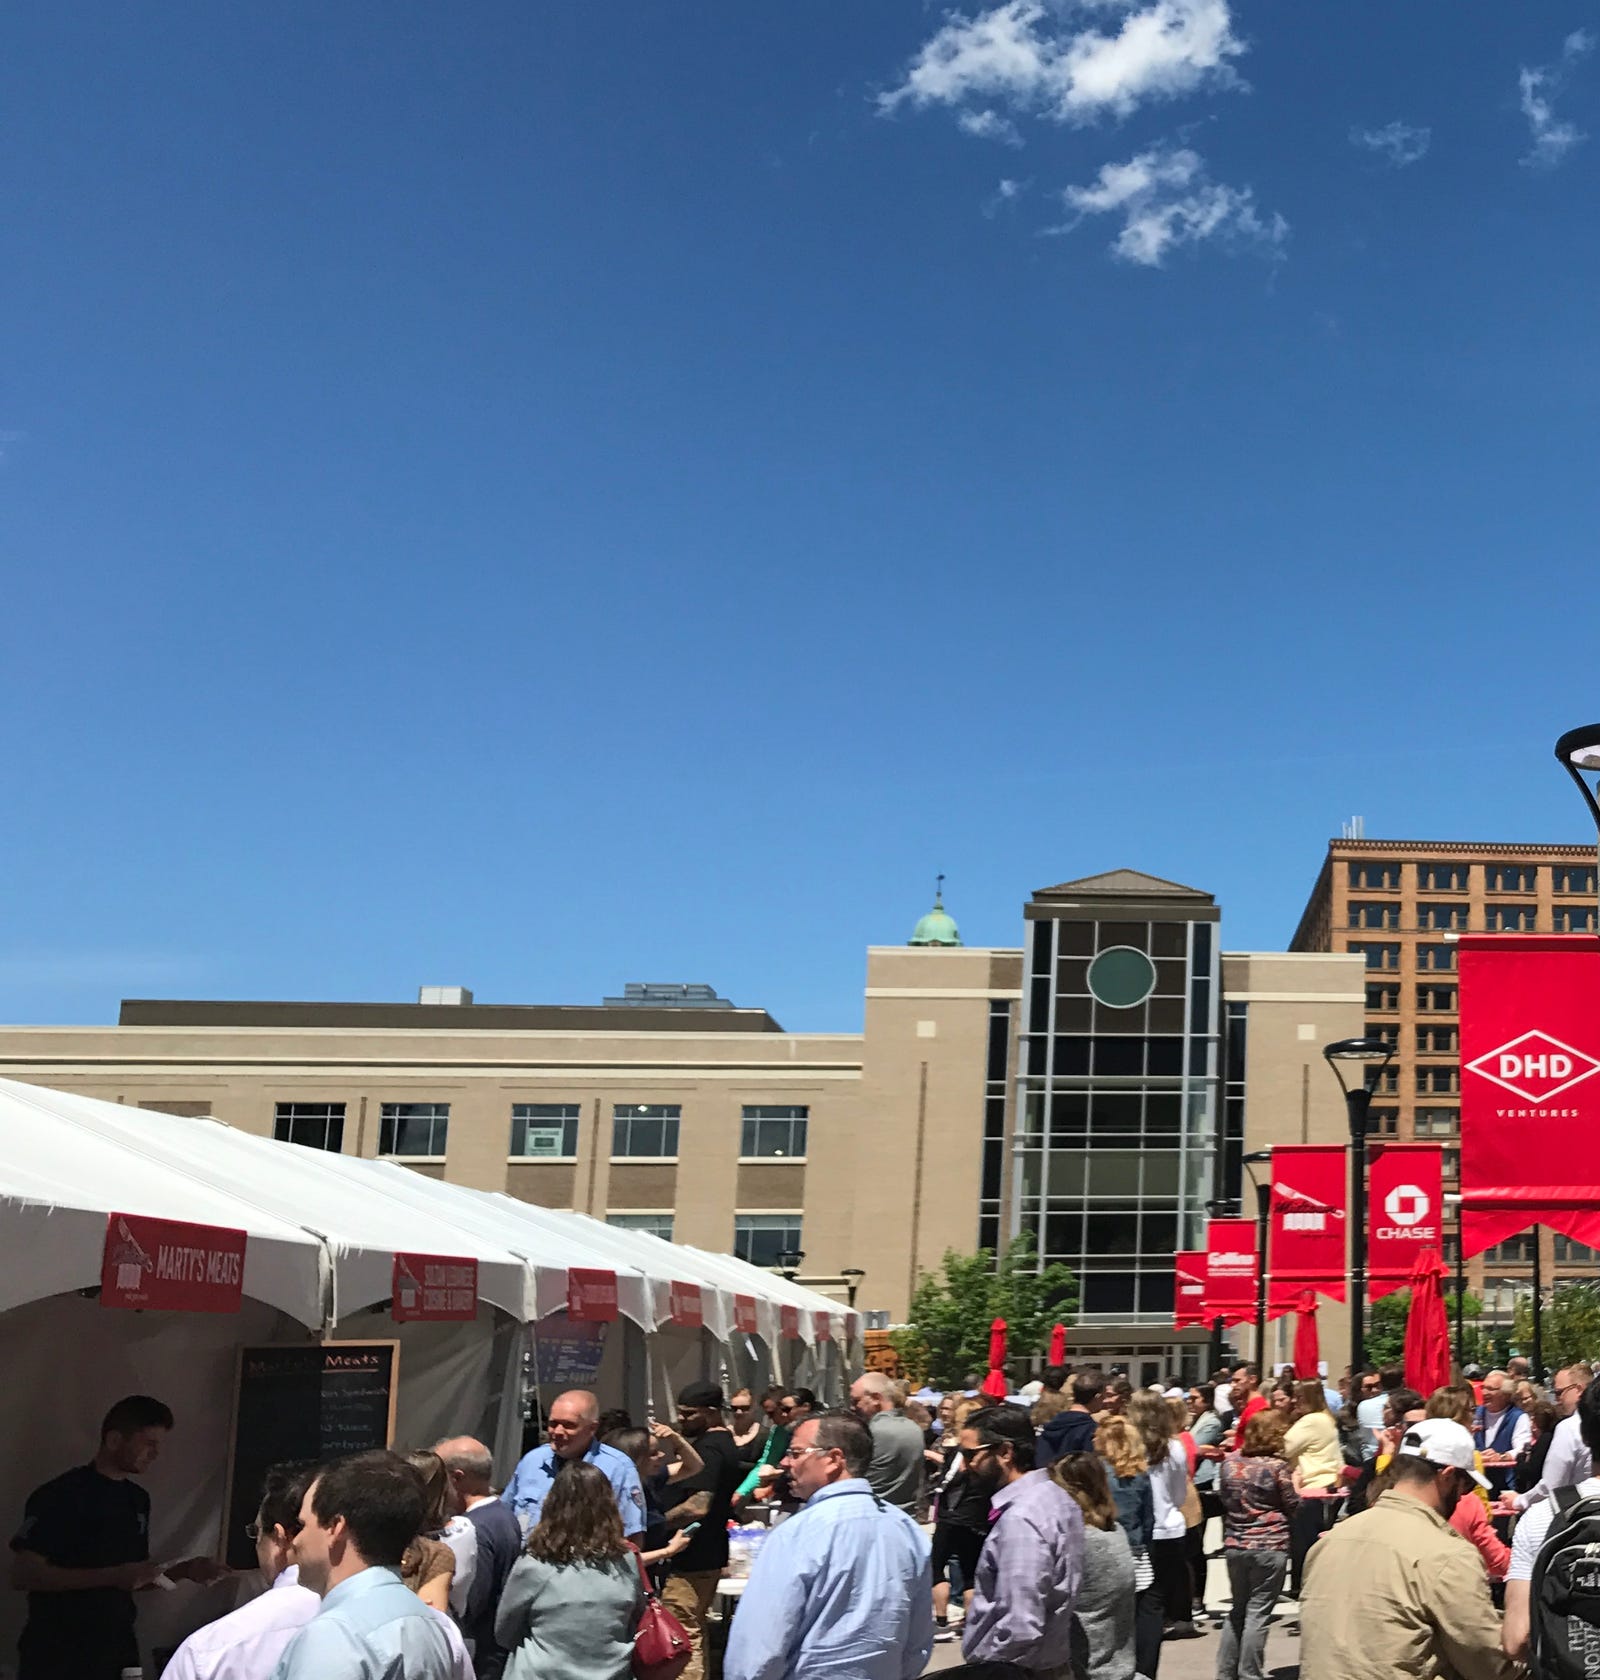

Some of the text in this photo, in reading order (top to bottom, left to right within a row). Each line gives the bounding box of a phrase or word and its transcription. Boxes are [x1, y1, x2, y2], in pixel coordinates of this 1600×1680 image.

[1500, 1054, 1573, 1079] DHD
[1496, 1109, 1579, 1118] VENTURES
[1376, 1227, 1436, 1240] CHASE
[156, 1244, 205, 1282] MARTY'S
[206, 1250, 240, 1285] MEATS
[325, 1354, 380, 1368] Meats
